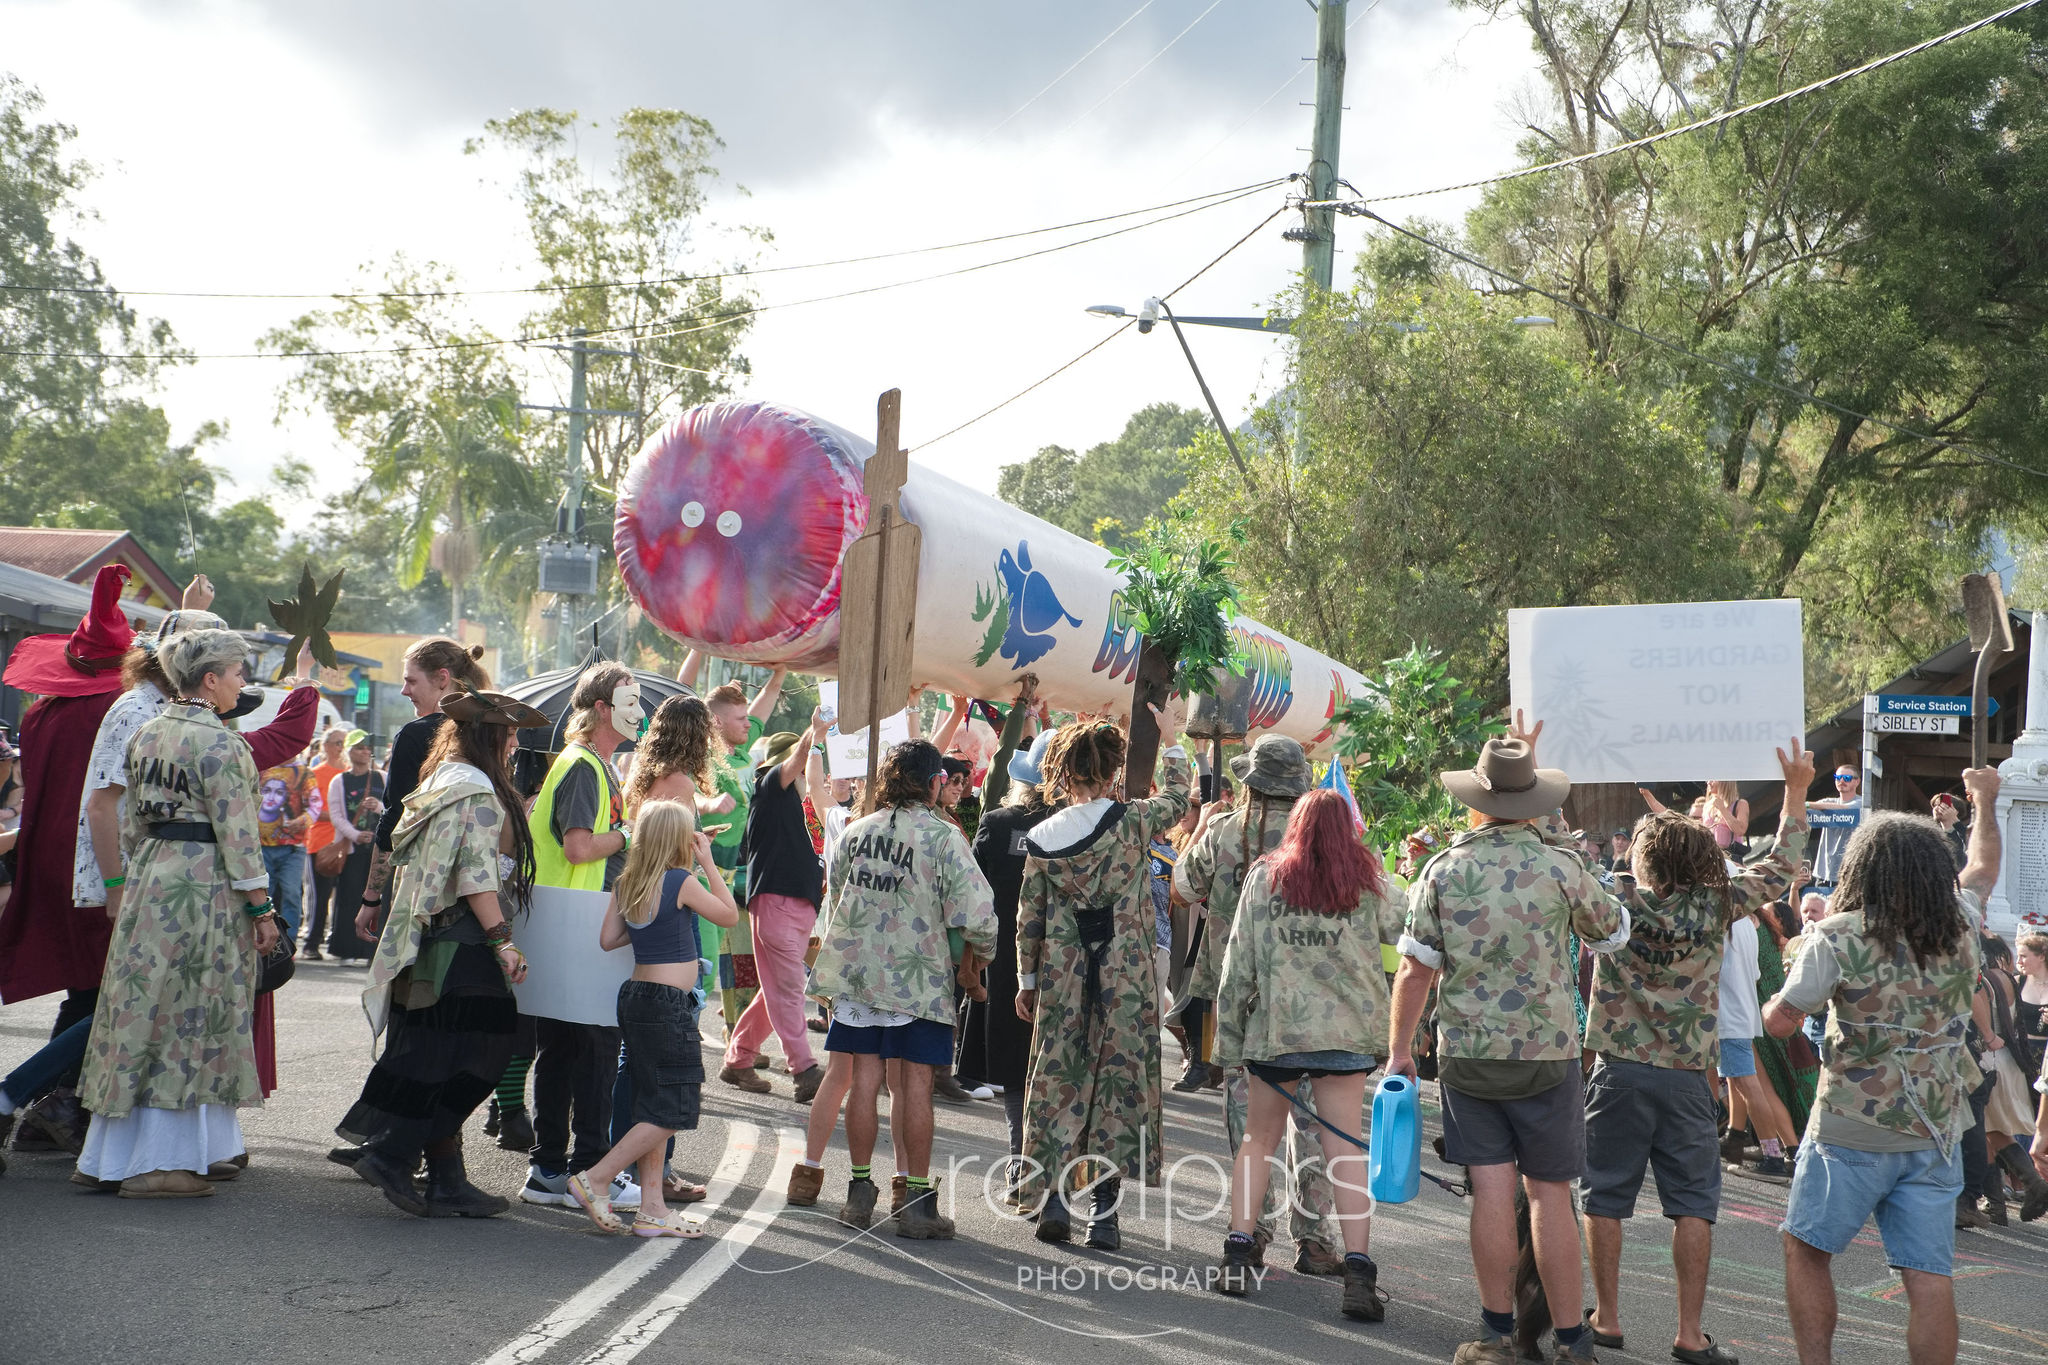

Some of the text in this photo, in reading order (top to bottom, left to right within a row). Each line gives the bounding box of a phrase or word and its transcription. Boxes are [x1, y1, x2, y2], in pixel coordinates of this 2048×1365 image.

[1888, 700, 1967, 711] Service Station
[1882, 716, 1947, 731] SIBLEY ST
[1813, 814, 1832, 823] Butter
[1832, 814, 1855, 824] Factory
[848, 834, 914, 876] GANJA
